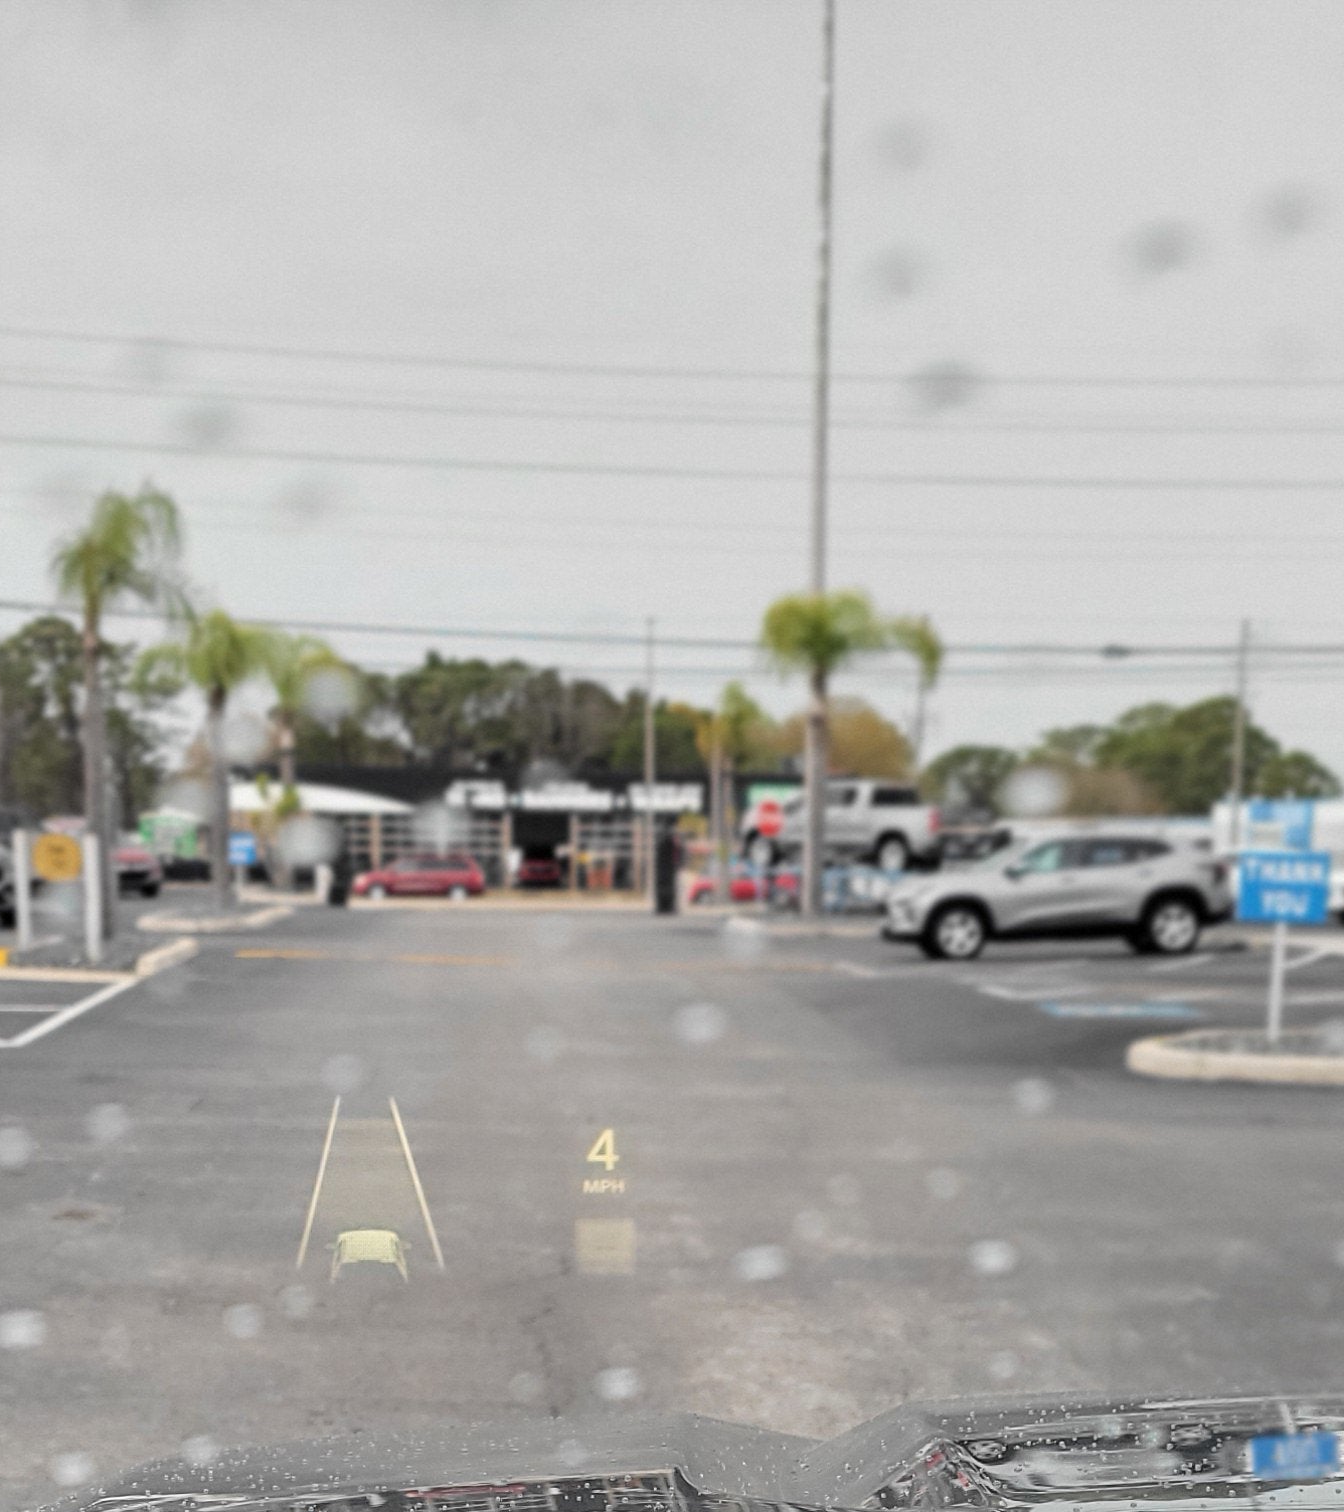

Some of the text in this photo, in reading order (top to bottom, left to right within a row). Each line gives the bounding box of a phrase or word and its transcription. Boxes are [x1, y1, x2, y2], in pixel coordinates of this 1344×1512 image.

[1244, 859, 1324, 882] THANK
[1261, 890, 1309, 915] YOU
[587, 1128, 620, 1171] 4
[582, 1179, 625, 1194] MPH
